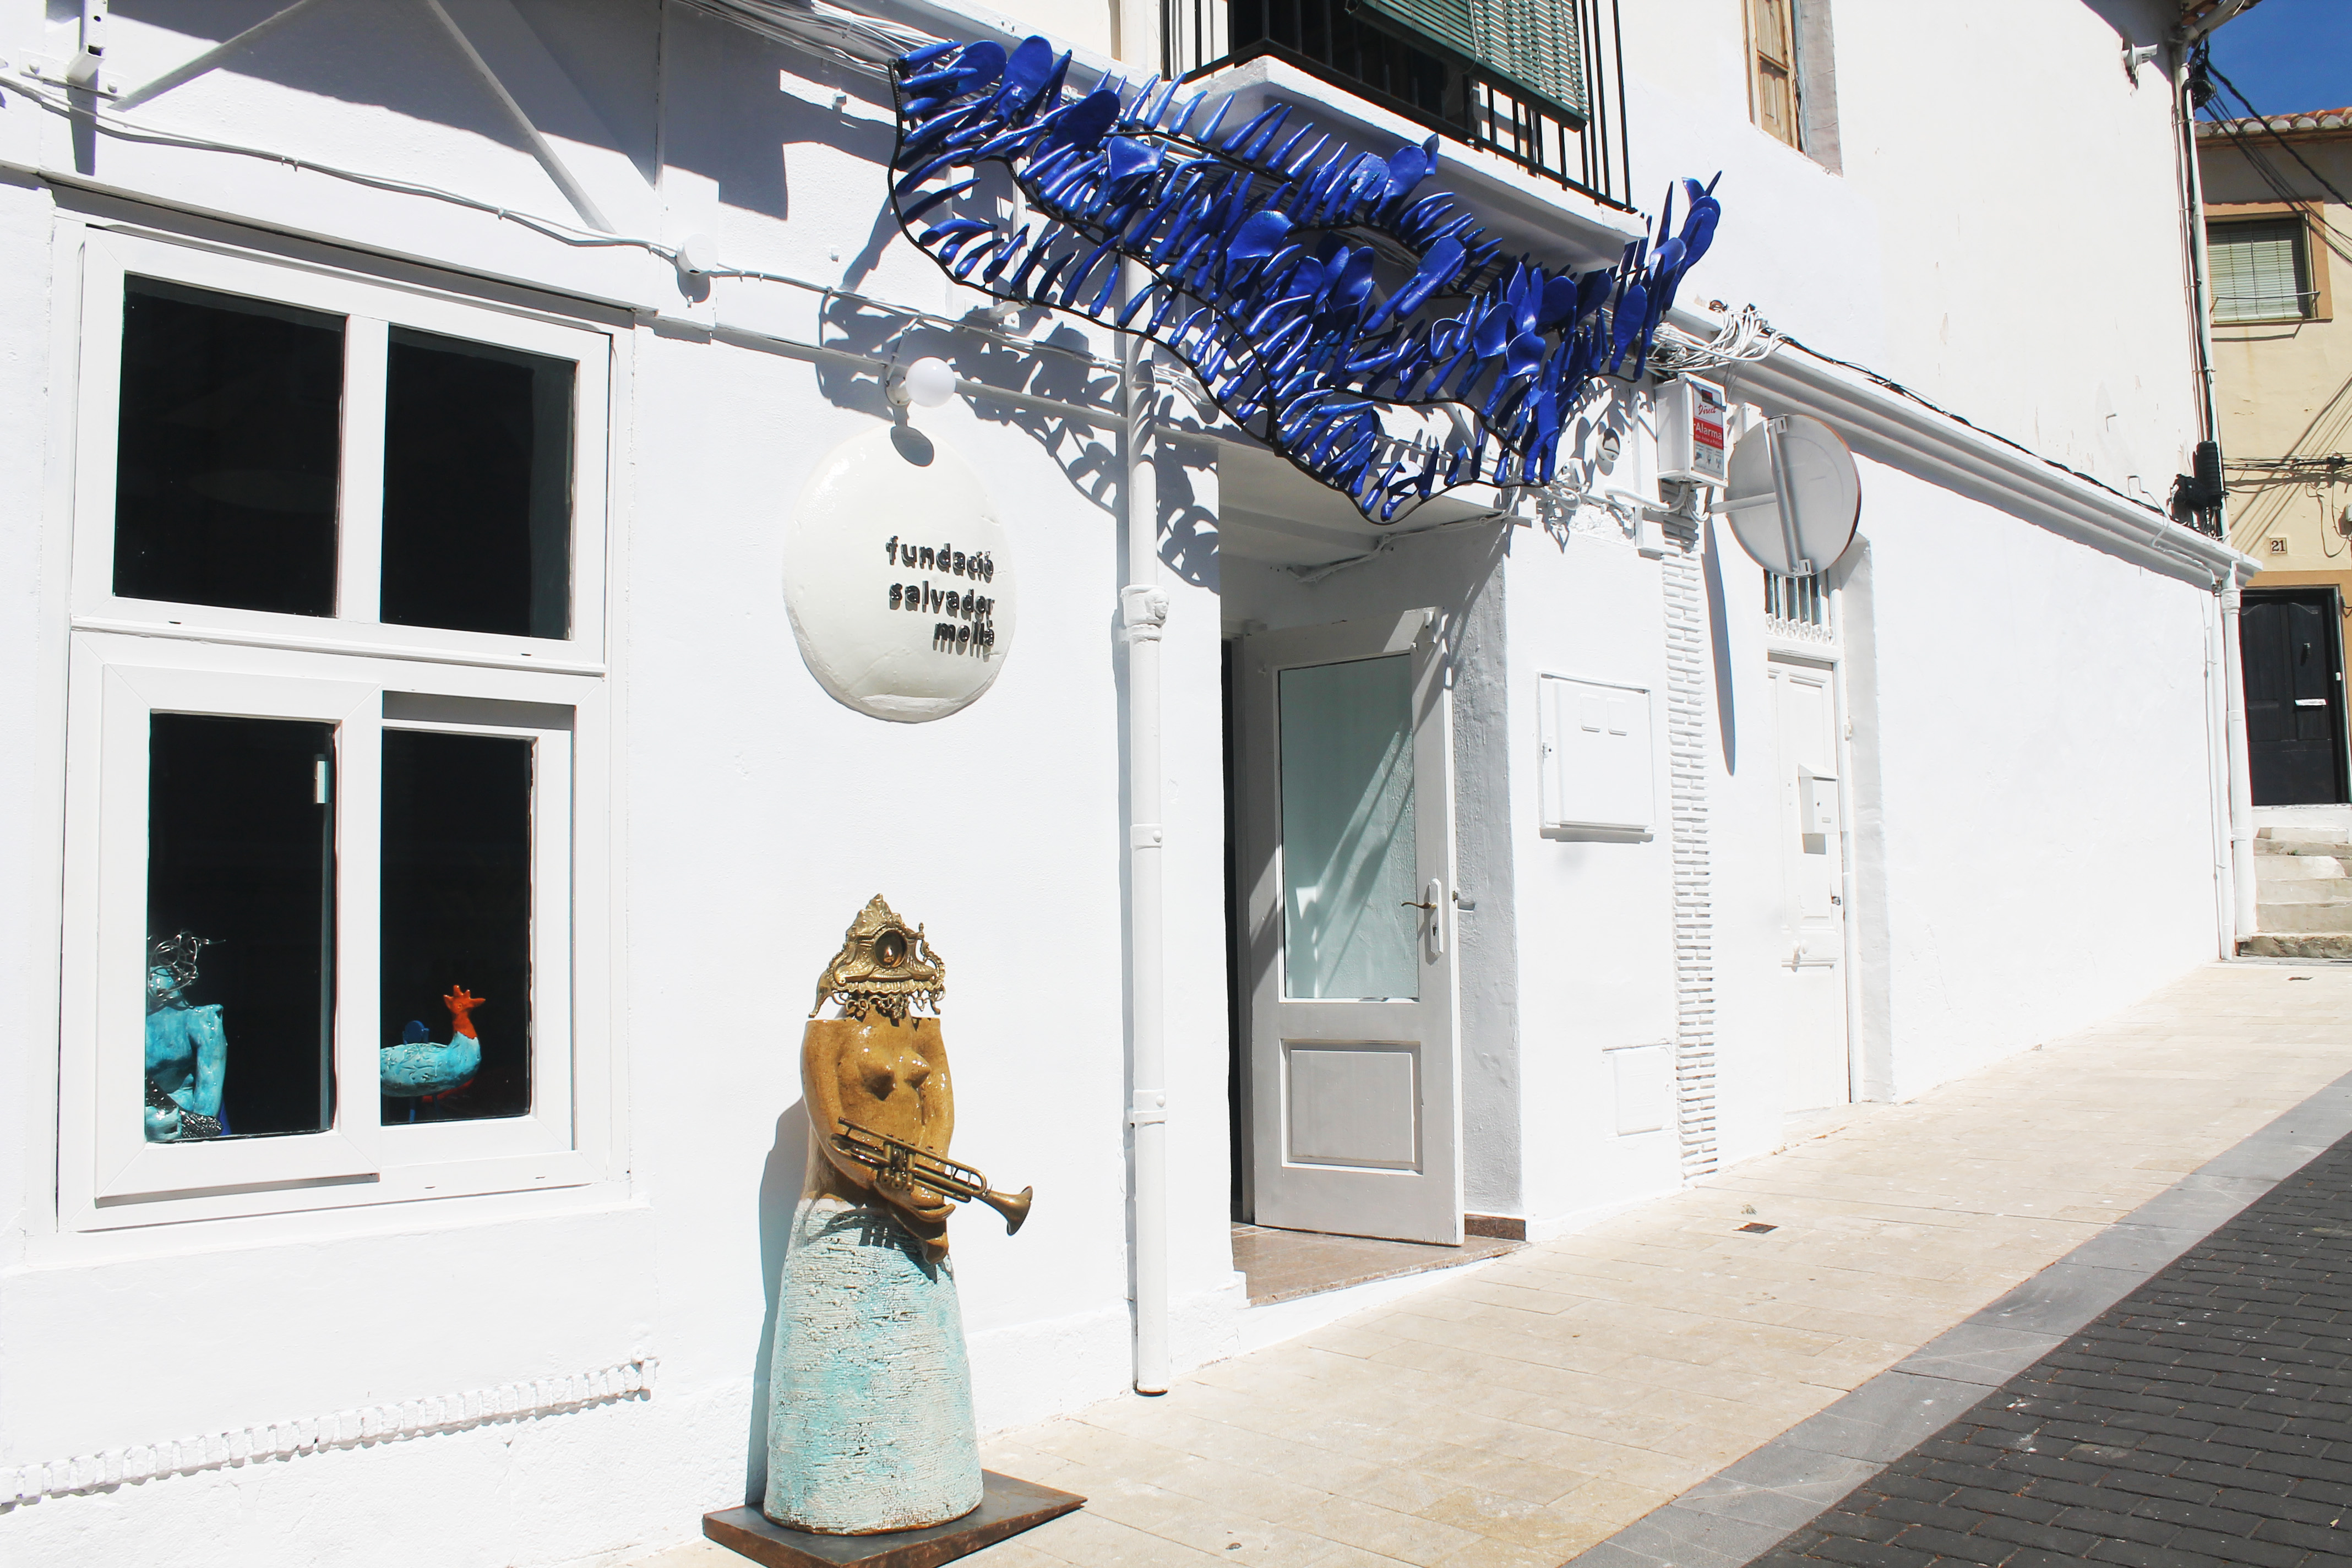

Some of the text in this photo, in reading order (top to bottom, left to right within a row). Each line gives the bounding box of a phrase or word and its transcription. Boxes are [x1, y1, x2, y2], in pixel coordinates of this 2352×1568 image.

[1696, 422, 1723, 440] Alarma
[886, 536, 994, 578] fundació
[2272, 540, 2285, 552] 21
[889, 581, 995, 616] salvador
